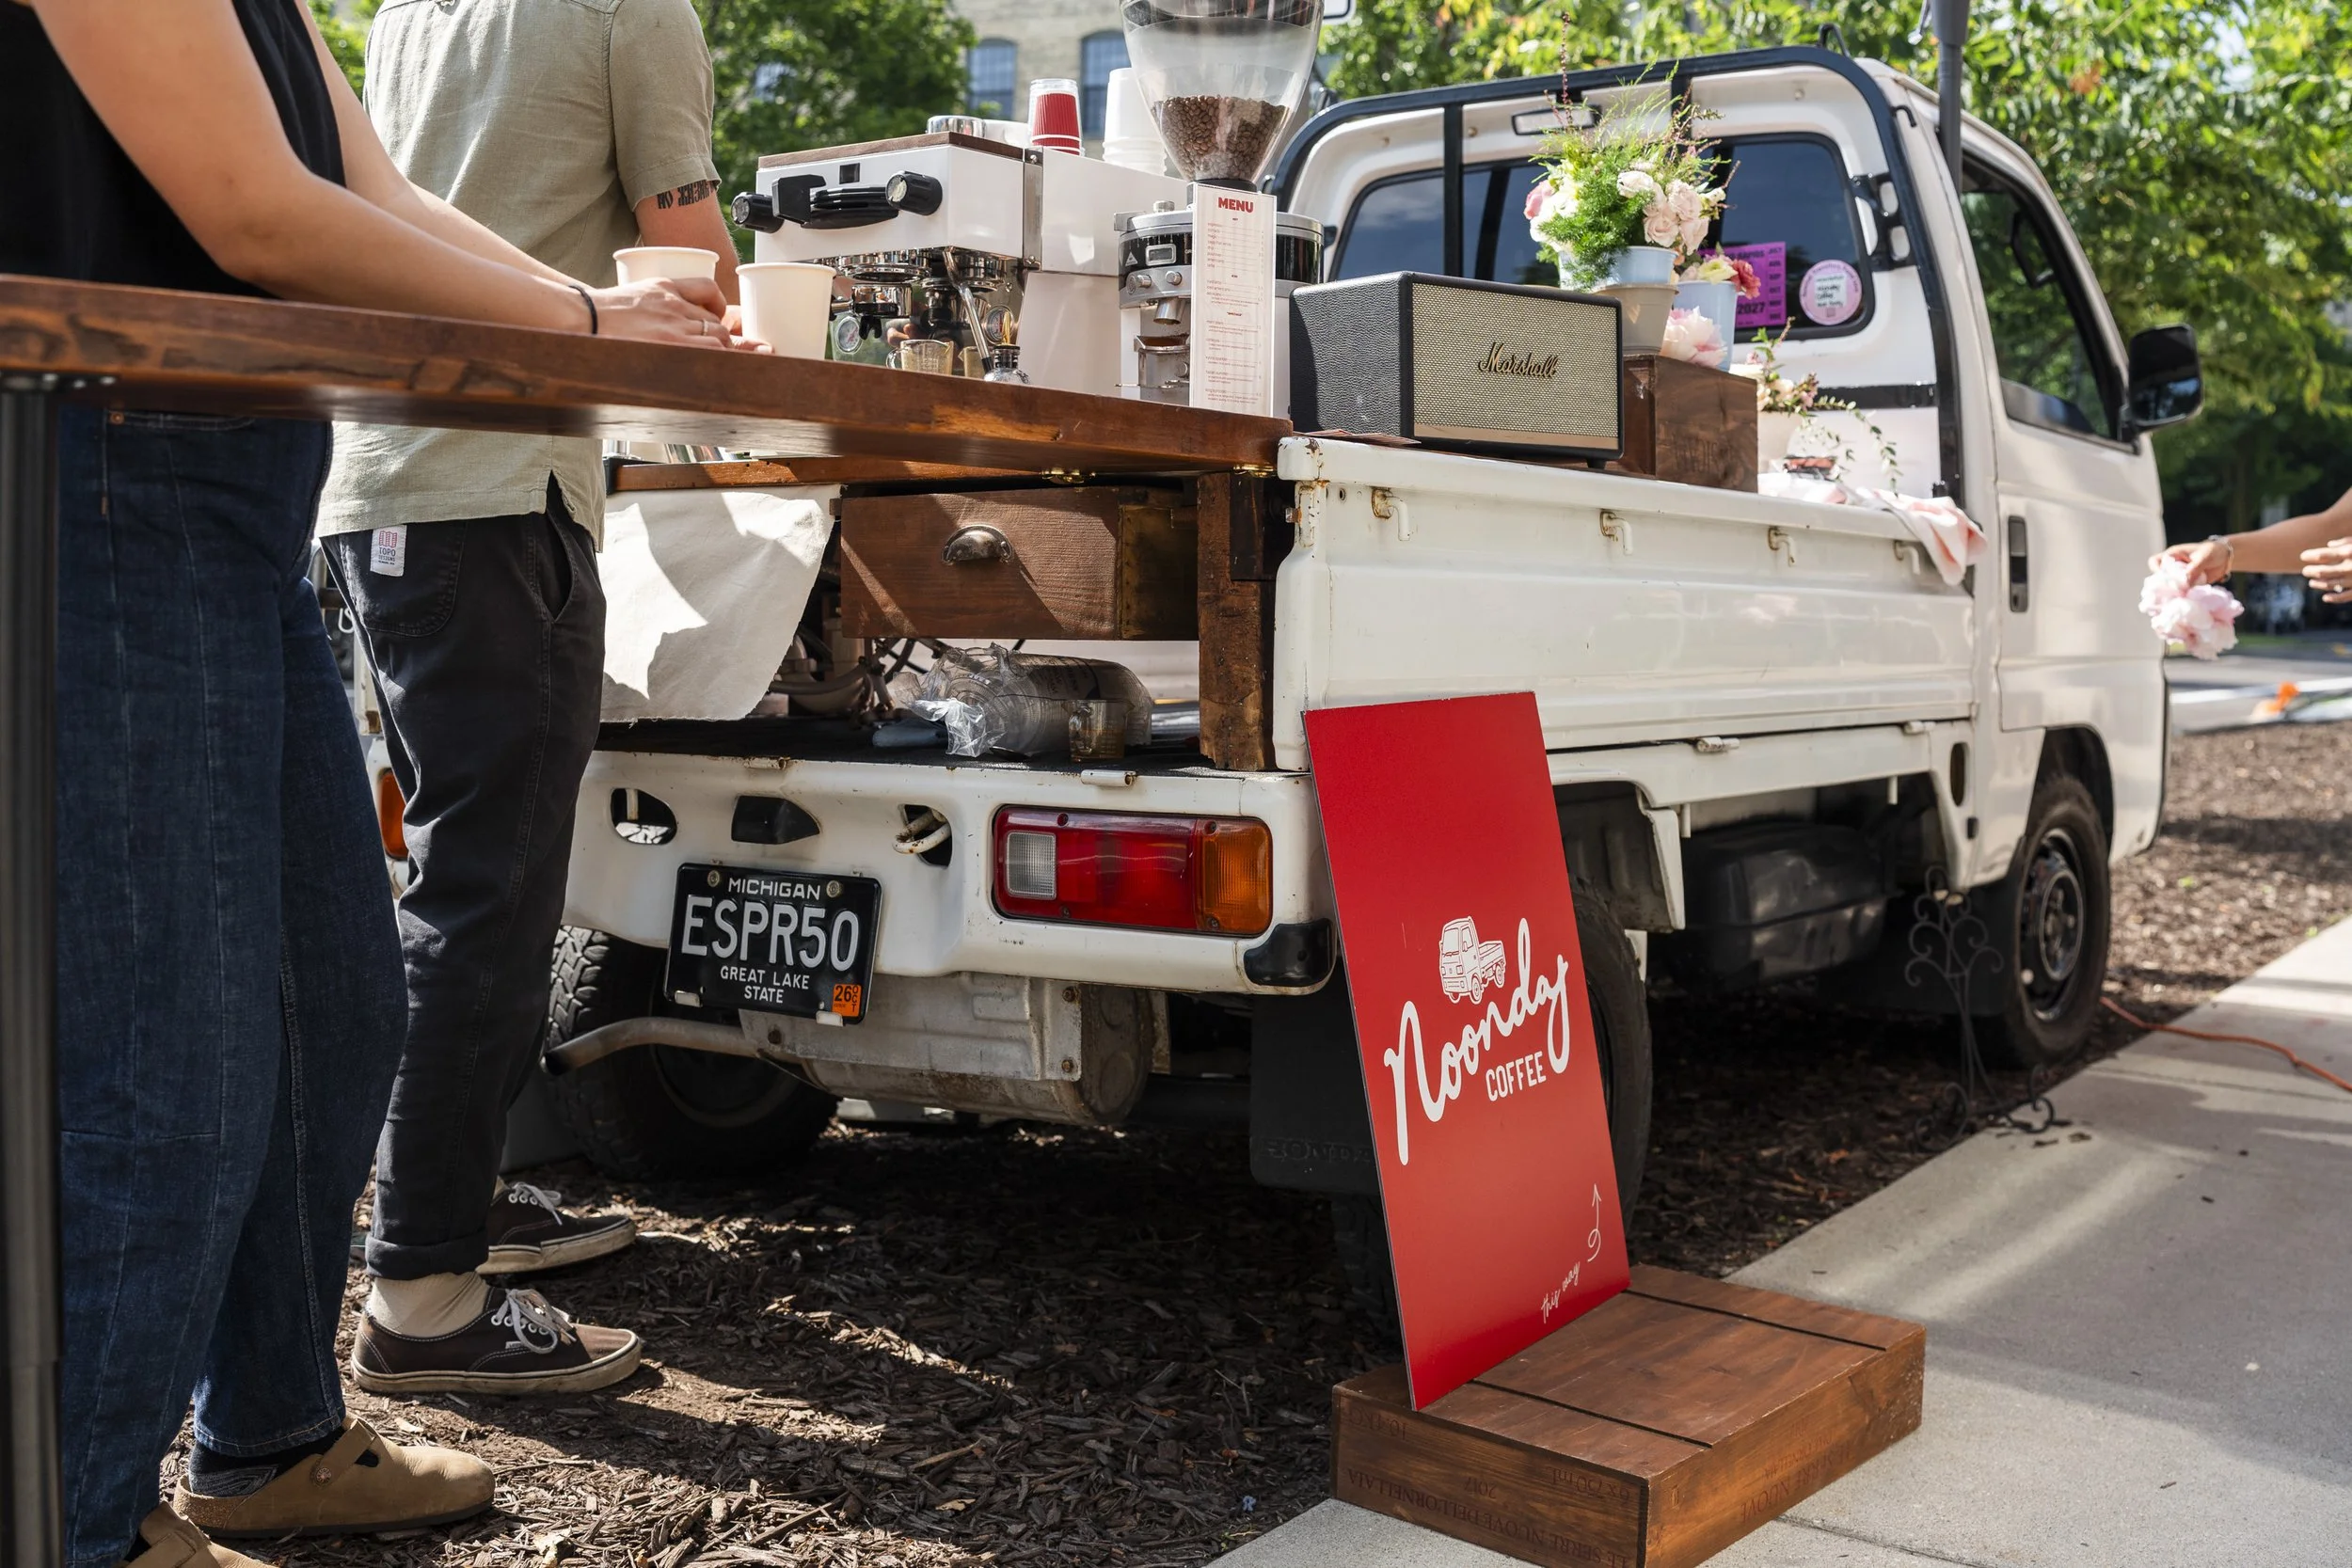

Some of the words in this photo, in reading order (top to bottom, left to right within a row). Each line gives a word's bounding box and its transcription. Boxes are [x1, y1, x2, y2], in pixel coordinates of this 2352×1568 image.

[1217, 197, 1254, 214] MENU
[1738, 303, 1766, 315] 2027
[1478, 341, 1560, 378] Marshall
[378, 546, 396, 557] TOPO
[727, 878, 820, 900] MICHIGAN
[720, 965, 766, 984] GREAT
[773, 973, 810, 990] LAKE
[744, 985, 785, 1004] STATE
[834, 985, 852, 1003] 26
[1384, 917, 1570, 1166] Noonday
[1486, 1051, 1547, 1102] COFFEE
[1541, 1288, 1562, 1324] this
[1562, 1260, 1581, 1292] way
[1464, 1476, 1498, 1499] 2017
[1484, 1512, 1545, 1547] NUOVE
[1548, 1533, 1602, 1564] SERRE
